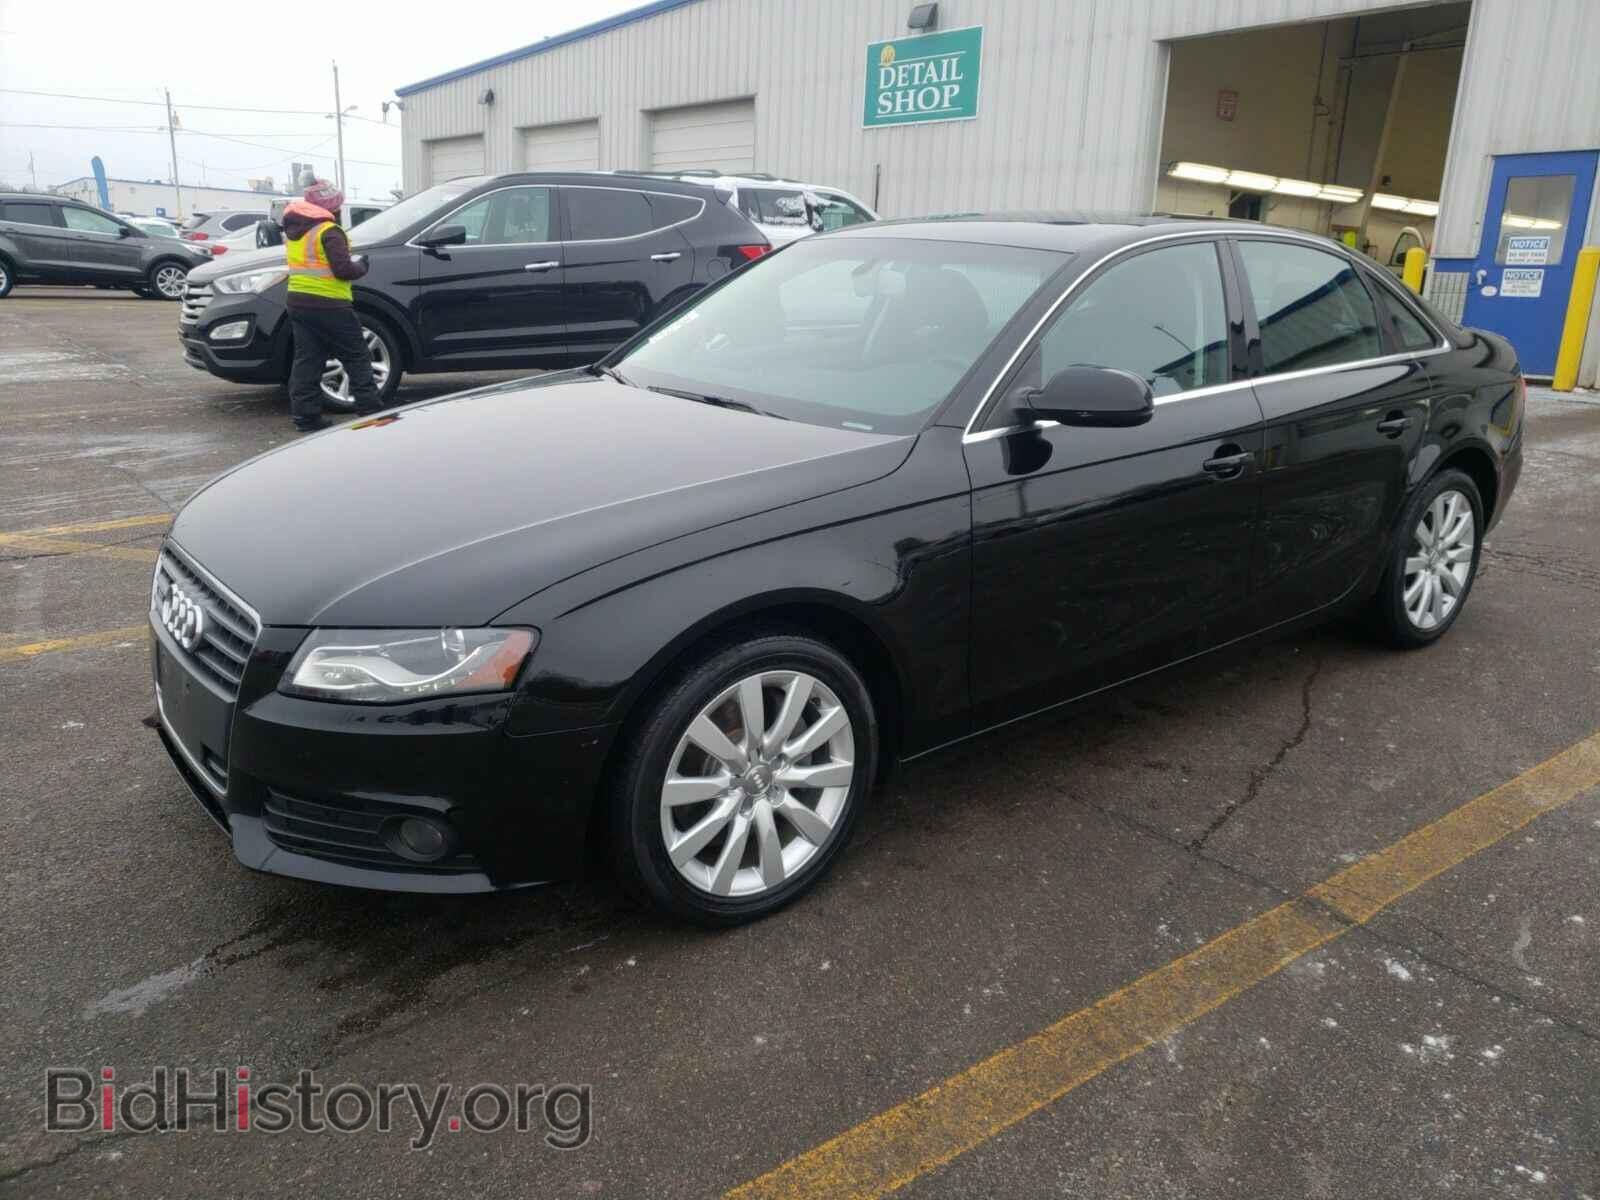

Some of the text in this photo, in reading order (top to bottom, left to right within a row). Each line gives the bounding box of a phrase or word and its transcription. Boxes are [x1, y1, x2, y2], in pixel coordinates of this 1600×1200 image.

[879, 57, 964, 89] DETAIL
[877, 84, 960, 115] SHOP
[1511, 239, 1547, 249] NOTICE
[1505, 271, 1541, 280] NOTICE
